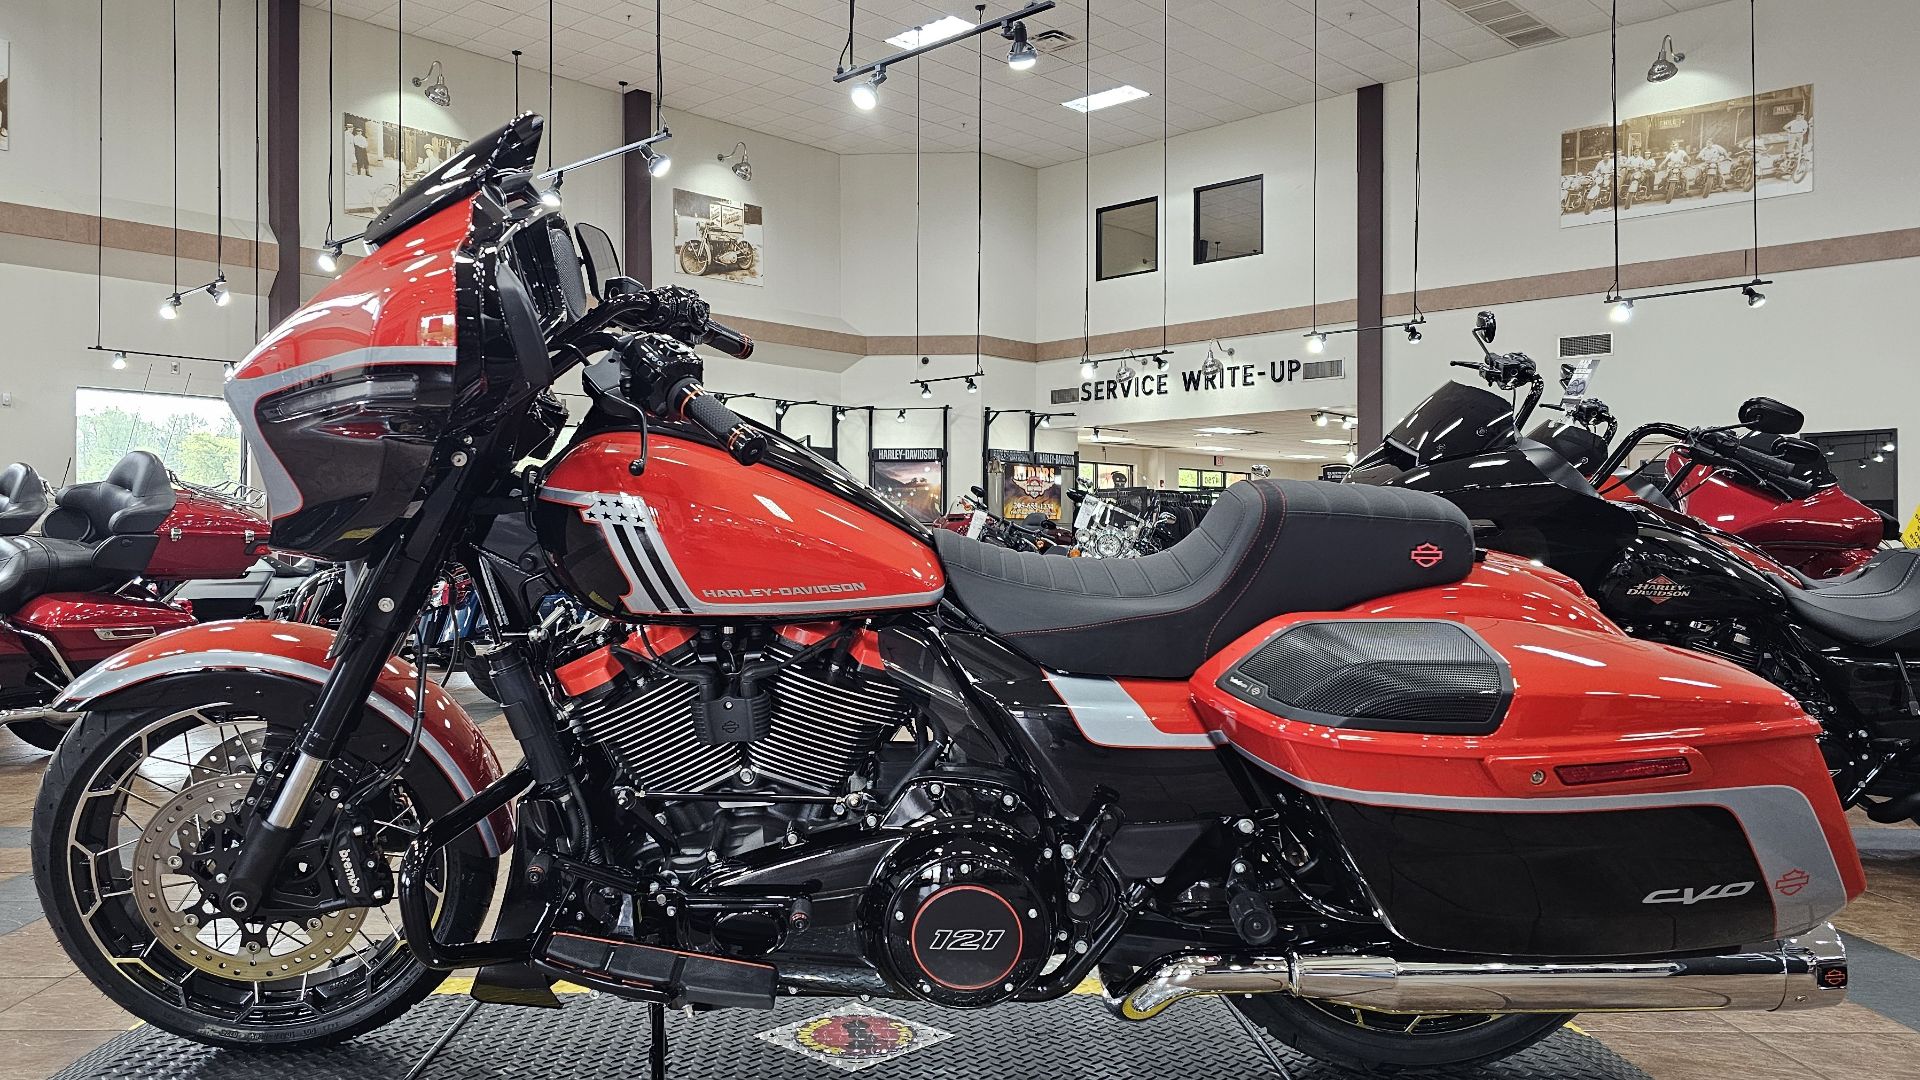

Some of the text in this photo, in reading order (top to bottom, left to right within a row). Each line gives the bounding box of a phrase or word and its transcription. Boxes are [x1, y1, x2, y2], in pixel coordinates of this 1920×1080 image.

[1081, 359, 1302, 401] SERVICE WRITE-UP
[878, 449, 938, 460] HARLEY-DAVIDSON
[702, 582, 867, 598] HARLEY-DAVIDSON
[1626, 588, 1691, 597] DAVIDSON
[1633, 583, 1686, 591] HARLEY
[338, 848, 361, 894] brembo
[1642, 881, 1756, 905] CVO
[929, 929, 1006, 951] 121
